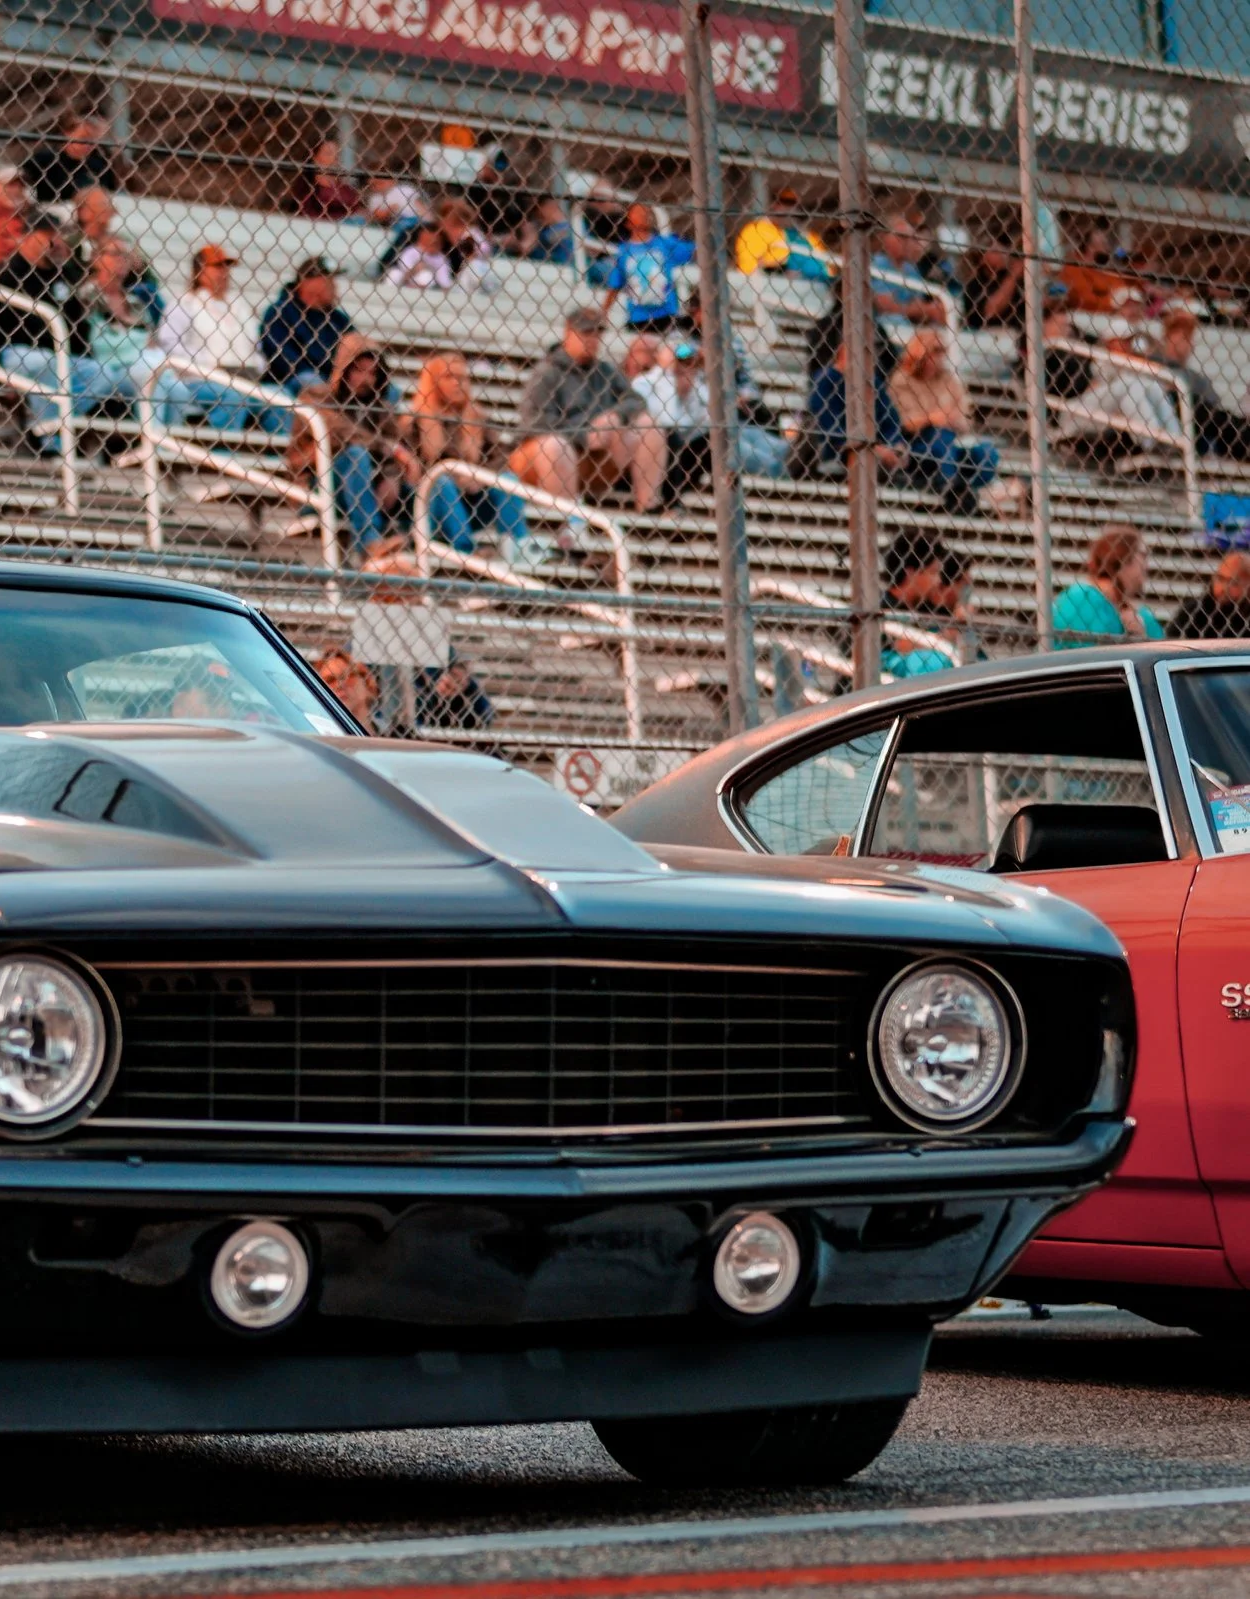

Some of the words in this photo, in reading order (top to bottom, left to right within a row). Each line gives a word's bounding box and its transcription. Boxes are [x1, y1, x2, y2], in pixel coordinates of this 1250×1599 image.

[427, 0, 580, 61] Auto
[581, 10, 733, 87] Pars
[1032, 77, 1190, 155] SERIES
